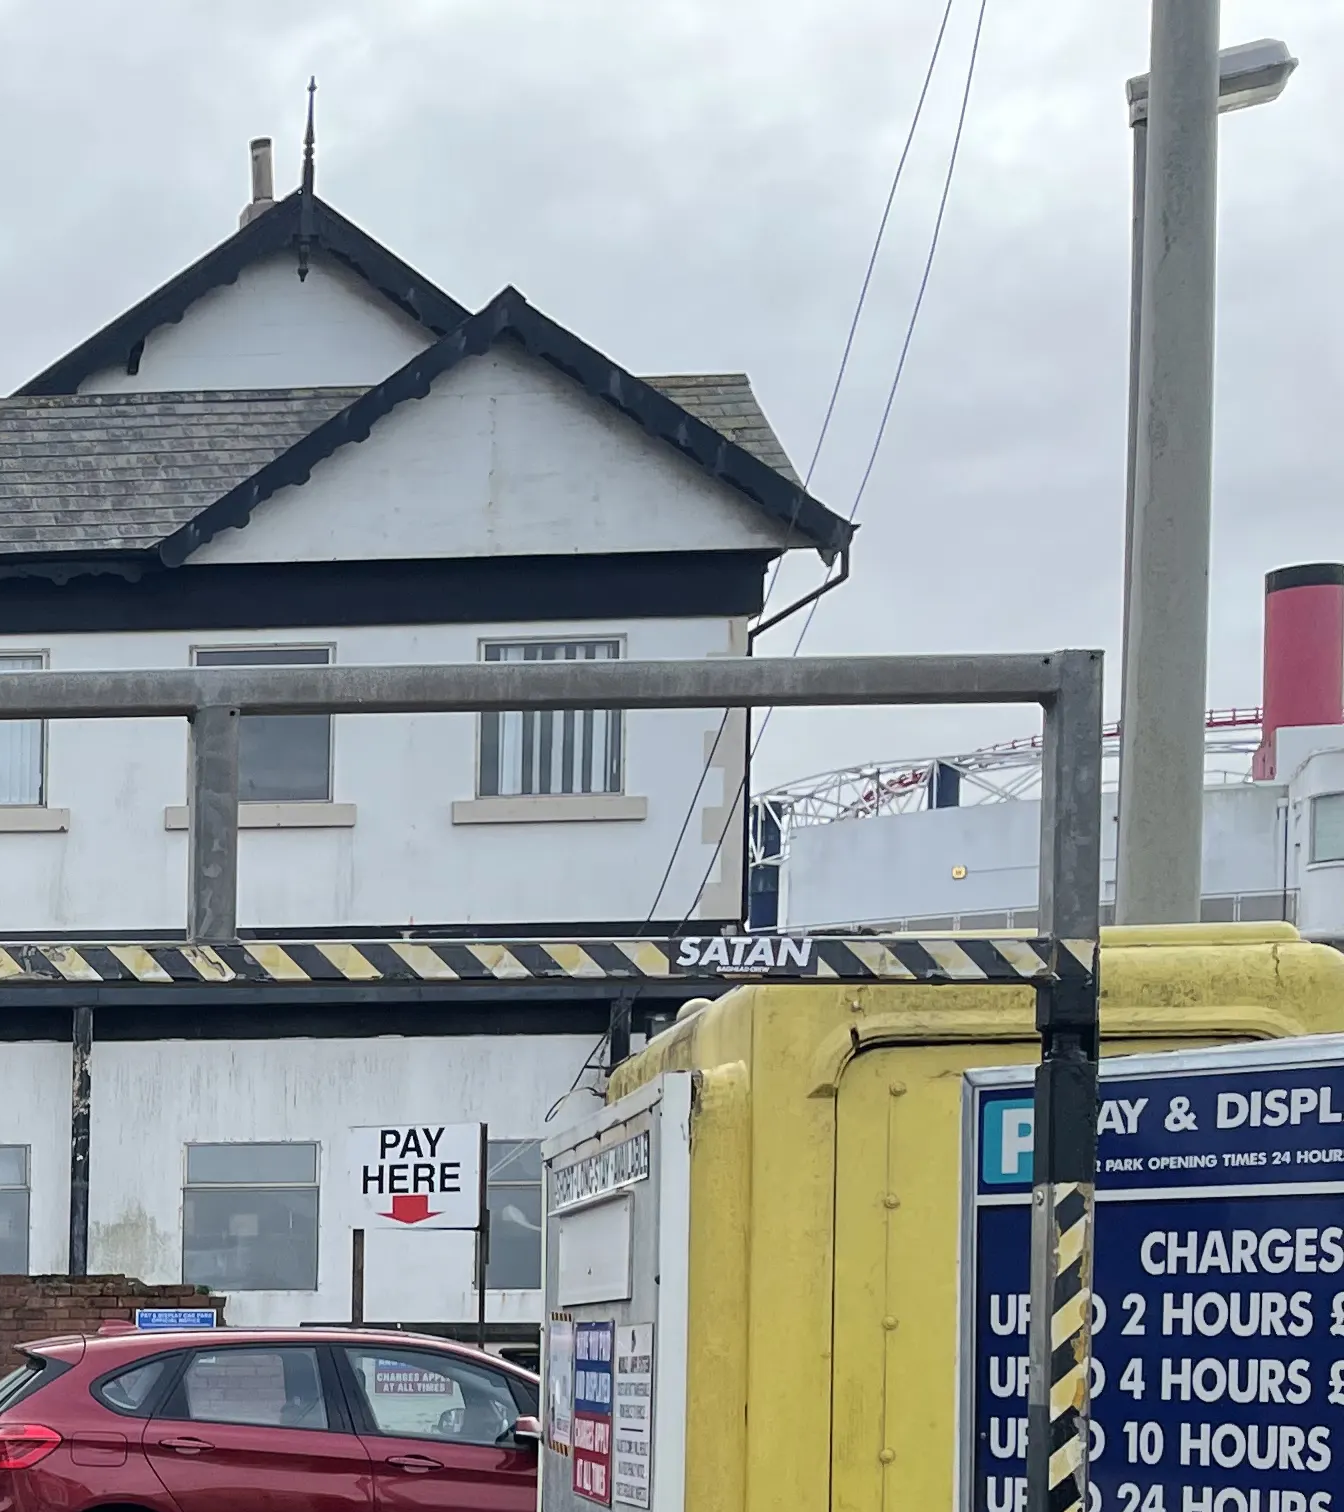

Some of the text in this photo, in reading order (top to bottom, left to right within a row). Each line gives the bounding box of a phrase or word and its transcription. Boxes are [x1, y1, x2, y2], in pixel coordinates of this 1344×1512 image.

[676, 936, 813, 967] SATAN
[1096, 1098, 1149, 1135] AY
[1164, 1096, 1198, 1133] &
[1216, 1086, 1344, 1129] DISPL
[380, 1127, 445, 1159] PAY
[1106, 1158, 1143, 1172] PARK
[1148, 1155, 1217, 1171] OPENING
[1222, 1152, 1267, 1167] TIMES
[1272, 1151, 1291, 1165] 24
[1296, 1149, 1344, 1165] HOUR
[362, 1162, 461, 1194] HERE
[1140, 1226, 1344, 1276] CHARGES
[1121, 1293, 1146, 1336] 2
[1162, 1292, 1313, 1338] HOURS
[383, 1383, 395, 1392] AT
[397, 1383, 414, 1392] ALL
[1120, 1357, 1146, 1401] 4
[1161, 1358, 1312, 1405] HOURS
[1122, 1421, 1164, 1465] 10
[1180, 1423, 1332, 1472] HOURS
